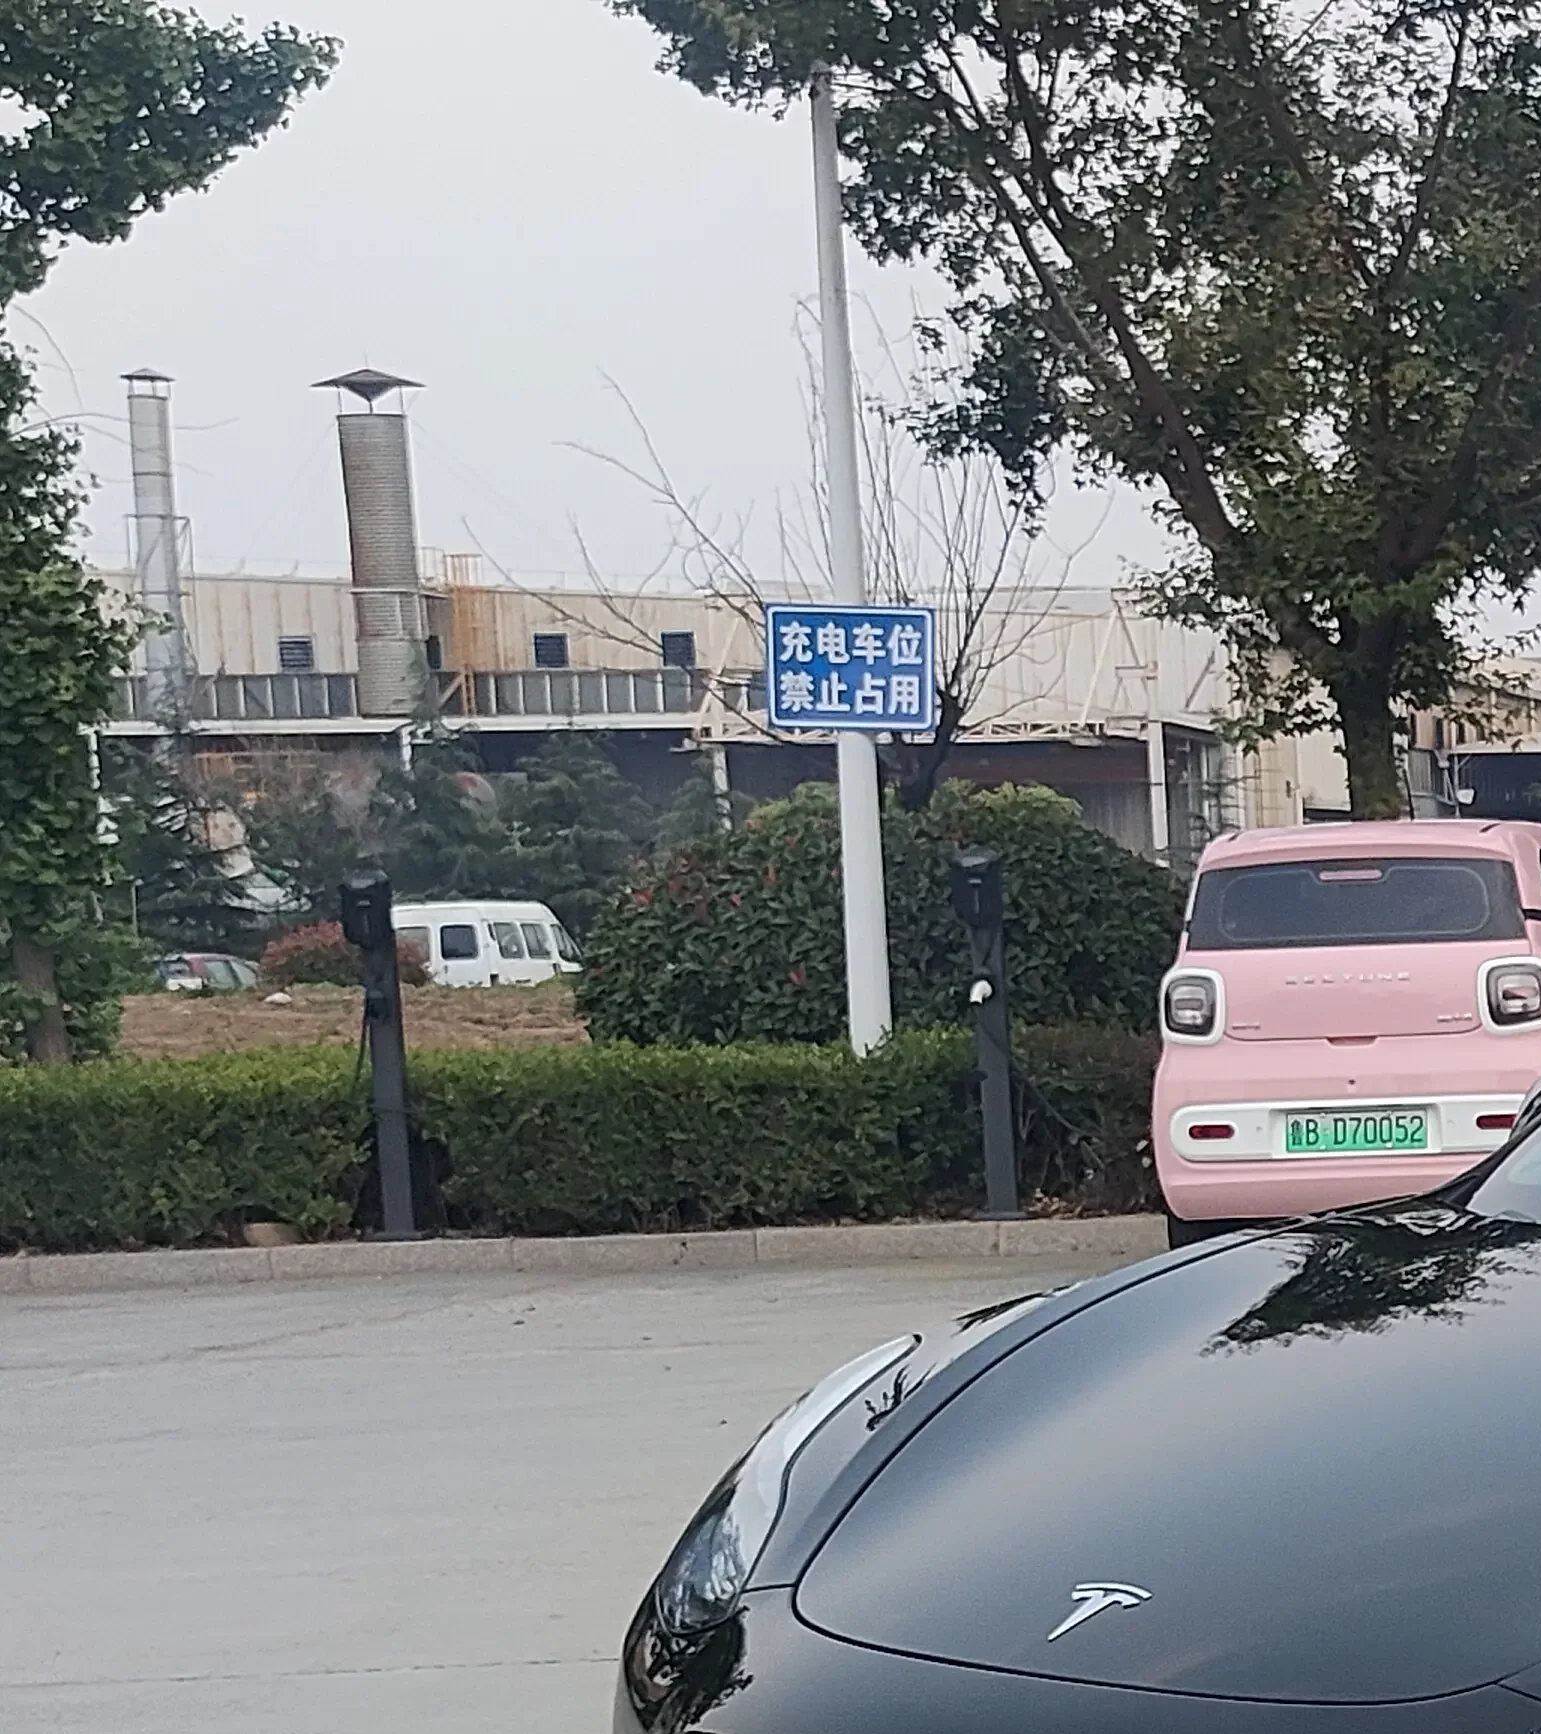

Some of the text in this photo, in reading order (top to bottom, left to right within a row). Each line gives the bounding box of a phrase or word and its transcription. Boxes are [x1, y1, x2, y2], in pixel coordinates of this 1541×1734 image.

[779, 621, 922, 666] 充电车位
[780, 670, 920, 715] 禁止占用
